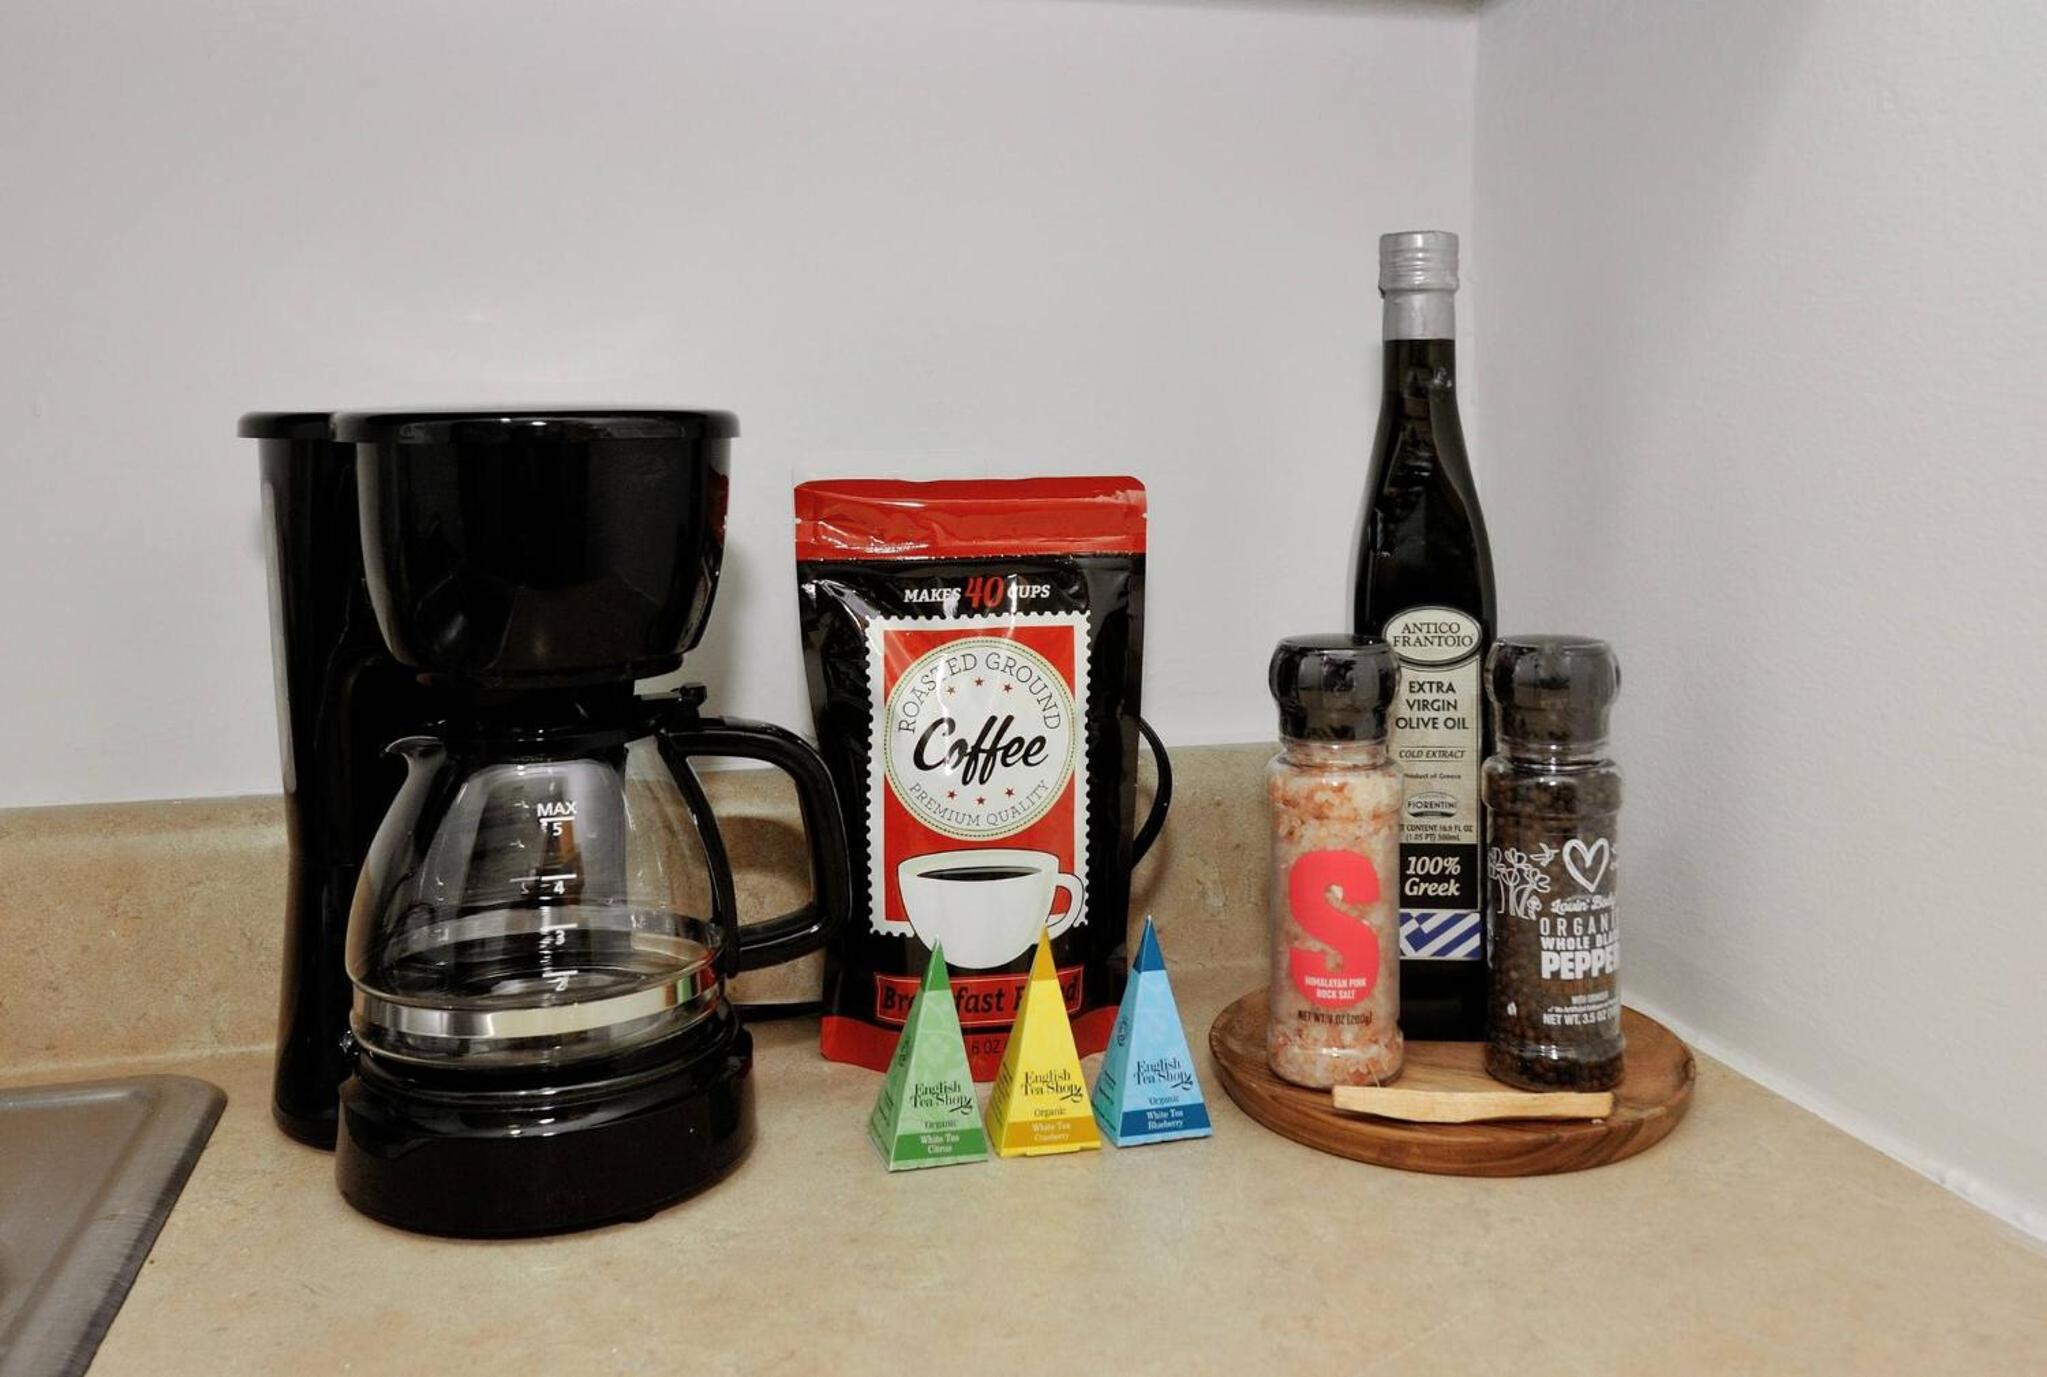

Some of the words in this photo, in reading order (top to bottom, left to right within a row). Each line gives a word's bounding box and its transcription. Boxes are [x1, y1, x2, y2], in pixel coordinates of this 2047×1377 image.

[904, 587, 962, 603] MAKES
[965, 576, 1004, 609] 40
[1401, 622, 1460, 634] ANTICO
[1393, 635, 1473, 647] FRANTOIO
[985, 652, 1061, 731] GROUND
[1408, 681, 1456, 694] EXTRA
[1406, 699, 1457, 712] VIRGIN
[1395, 717, 1439, 730] OLIVE
[1443, 717, 1469, 730] OIL
[913, 714, 1049, 786] Coffee
[1399, 750, 1423, 759] COLD
[1425, 750, 1466, 759] EXTRACT
[537, 802, 577, 817] MAX
[909, 782, 980, 827] PREMIUM
[987, 781, 1050, 827] QUALITY
[553, 822, 563, 836] 5
[1406, 824, 1437, 832] CONTENT
[1406, 856, 1461, 875] 100%
[554, 881, 565, 895] 4
[1404, 877, 1461, 896] Greek
[1289, 849, 1380, 1008] S
[556, 930, 565, 945] 3
[1540, 936, 1590, 951] WHOLE
[1305, 976, 1347, 988] HIMALAYAN
[1349, 977, 1366, 987] PINK
[883, 984, 1005, 1013] Brfast
[1338, 989, 1355, 999] SALT
[1543, 1013, 1561, 1025] NET
[1582, 1012, 1596, 1024] 3.5
[1136, 1057, 1182, 1073] English
[1024, 1068, 1071, 1084] English
[1133, 1072, 1156, 1085] Tea
[1157, 1070, 1193, 1091] Shop
[914, 1081, 961, 1097] English
[1021, 1082, 1044, 1096] Tea
[1046, 1081, 1083, 1103] Shop
[910, 1095, 933, 1108] Tea
[935, 1093, 973, 1115] Shop
[1146, 1110, 1168, 1120] White
[1169, 1108, 1184, 1118] Tea
[920, 1134, 943, 1145] White
[944, 1132, 960, 1143] Tea
